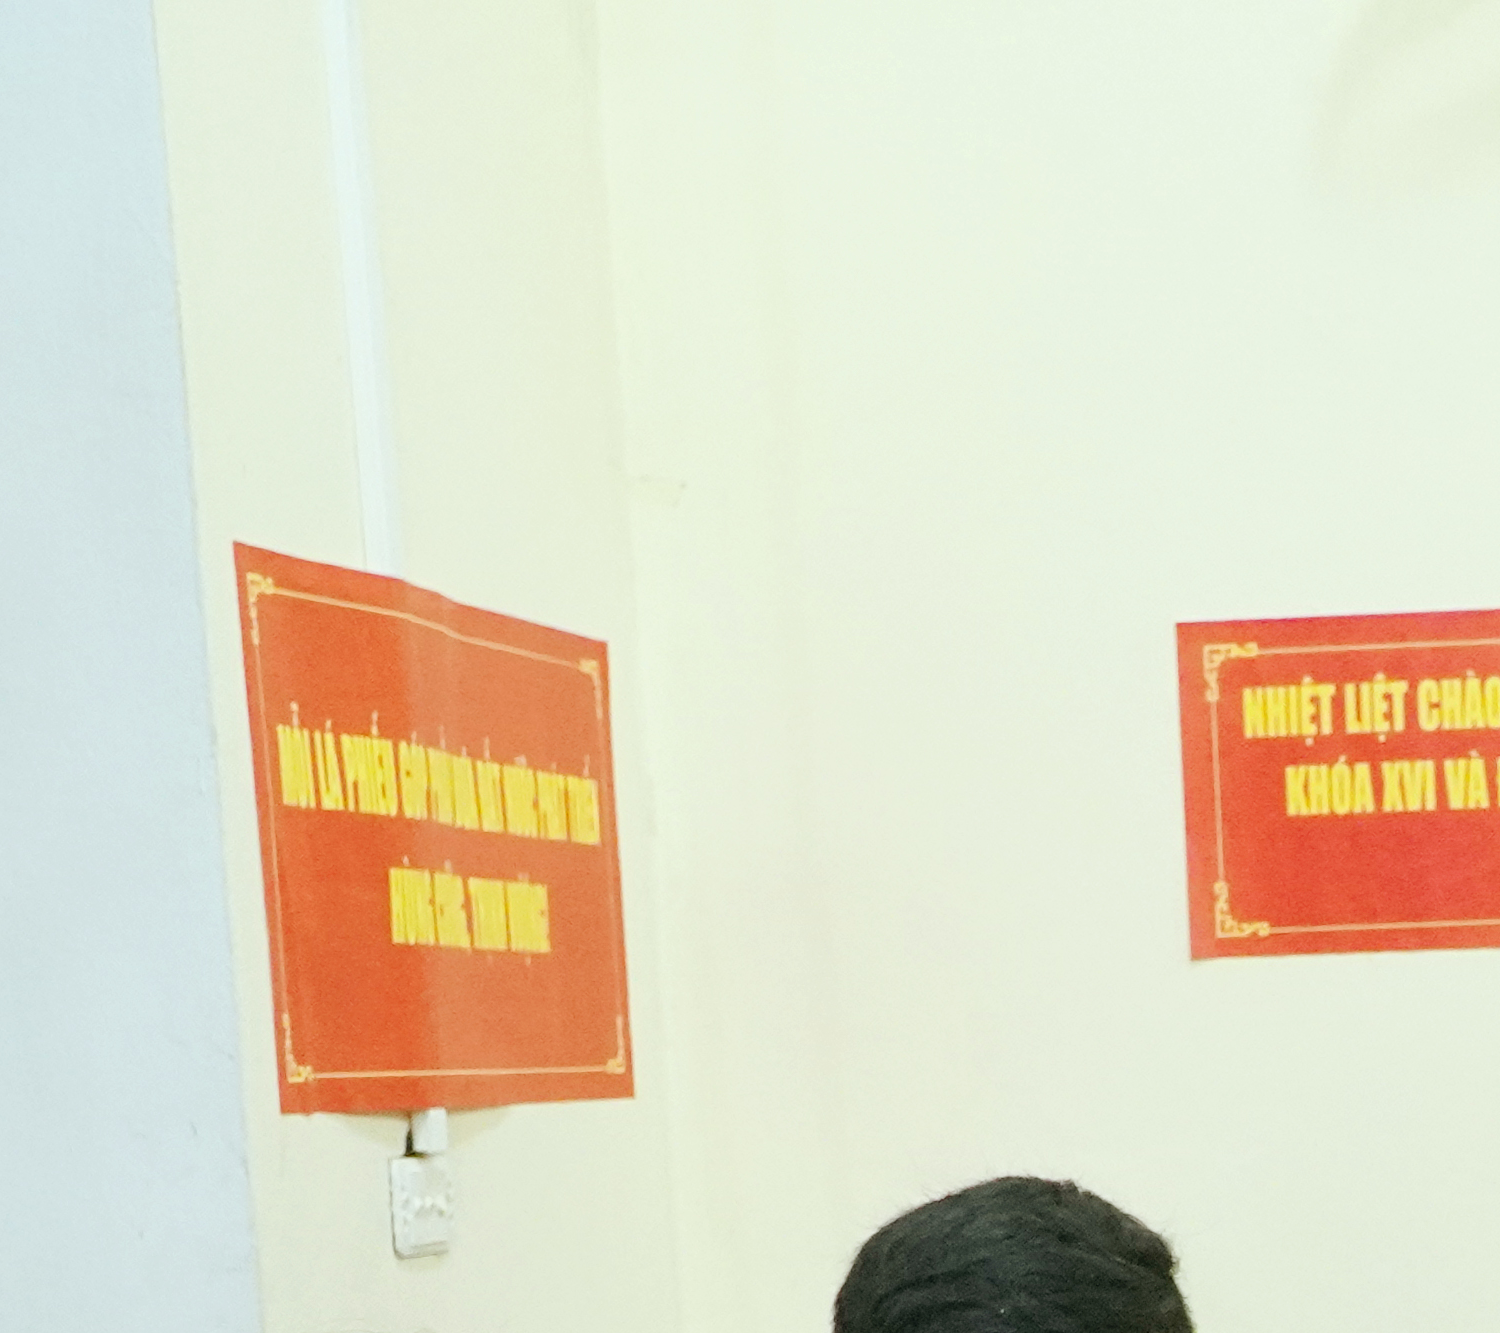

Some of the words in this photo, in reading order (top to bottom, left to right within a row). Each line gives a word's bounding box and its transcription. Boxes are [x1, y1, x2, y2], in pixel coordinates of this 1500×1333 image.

[1242, 676, 1336, 746] NHIỆT
[1344, 673, 1408, 742] LIỆT
[1284, 755, 1375, 816] KHÓA
[1381, 759, 1437, 813] XVI
[1443, 749, 1490, 810] VÀ
